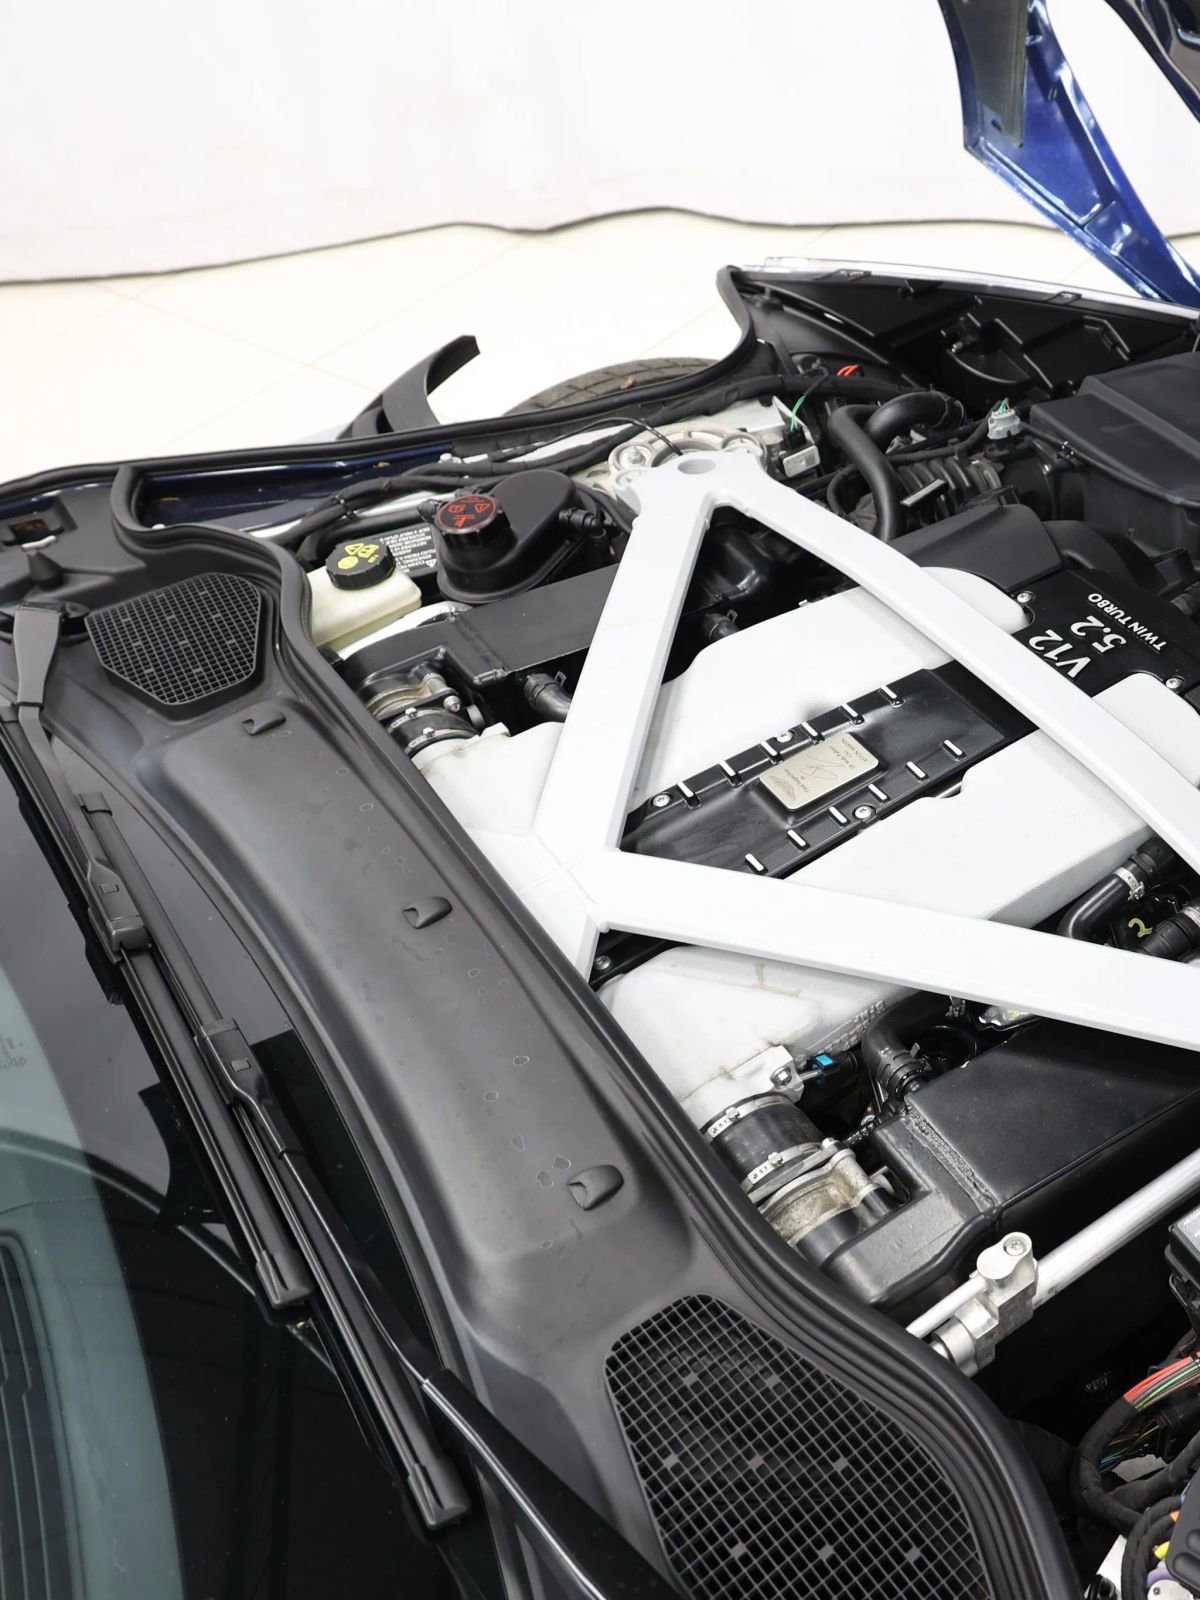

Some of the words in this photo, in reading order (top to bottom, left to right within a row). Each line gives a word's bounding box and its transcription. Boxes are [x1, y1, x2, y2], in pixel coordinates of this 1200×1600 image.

[1088, 593, 1132, 626] TURBO
[1070, 615, 1127, 653] 5.2
[1128, 622, 1168, 651] TWIN
[1028, 629, 1092, 679] V12
